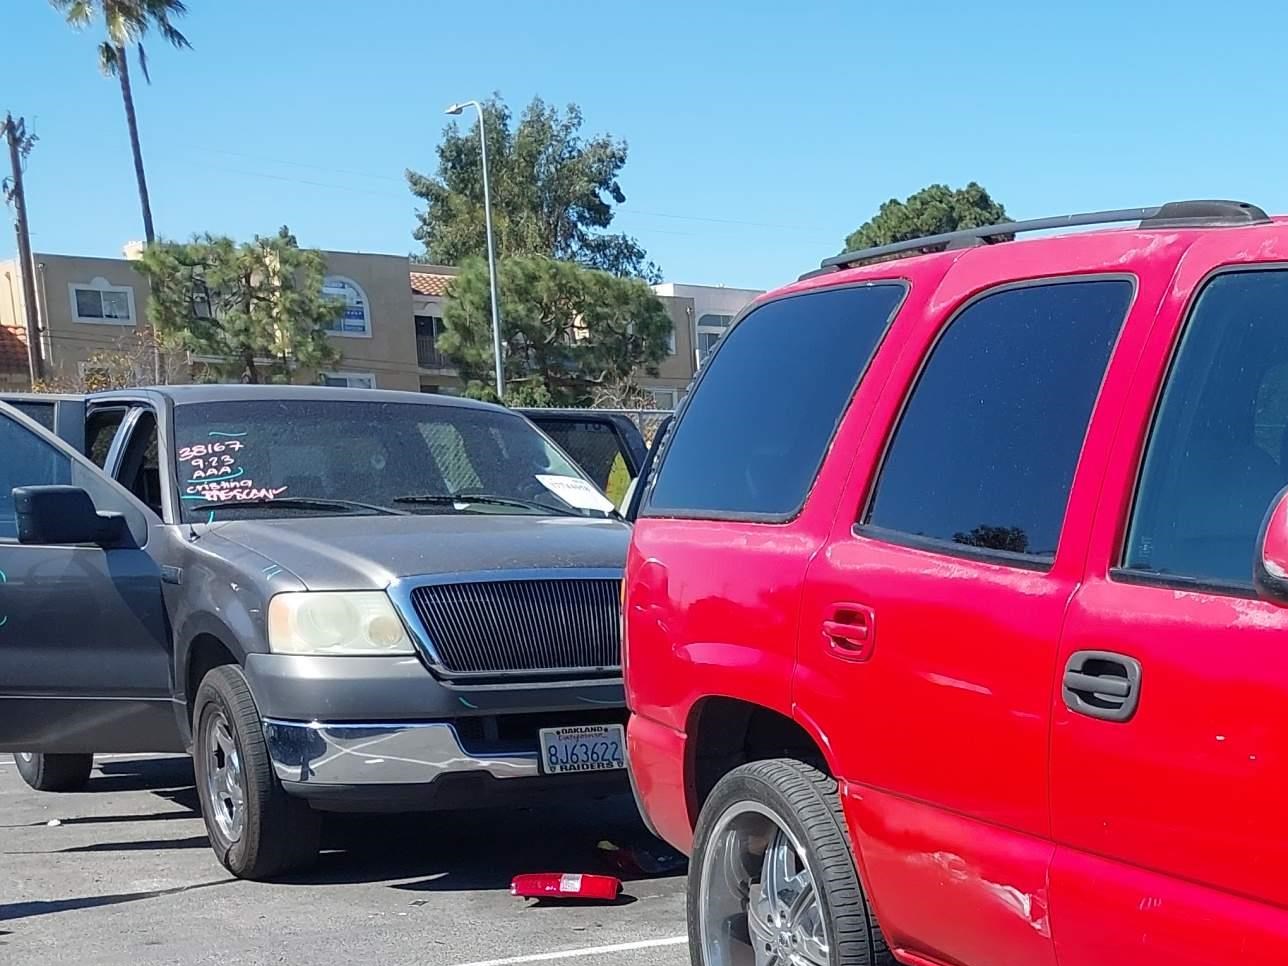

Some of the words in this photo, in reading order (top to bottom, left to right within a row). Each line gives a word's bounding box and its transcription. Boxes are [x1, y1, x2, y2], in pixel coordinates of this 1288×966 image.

[179, 441, 244, 461] 38167
[193, 466, 232, 479] AAA
[561, 726, 603, 735] OAKLAND
[548, 741, 621, 765] 8J63622
[559, 761, 614, 772] RAIDERS
